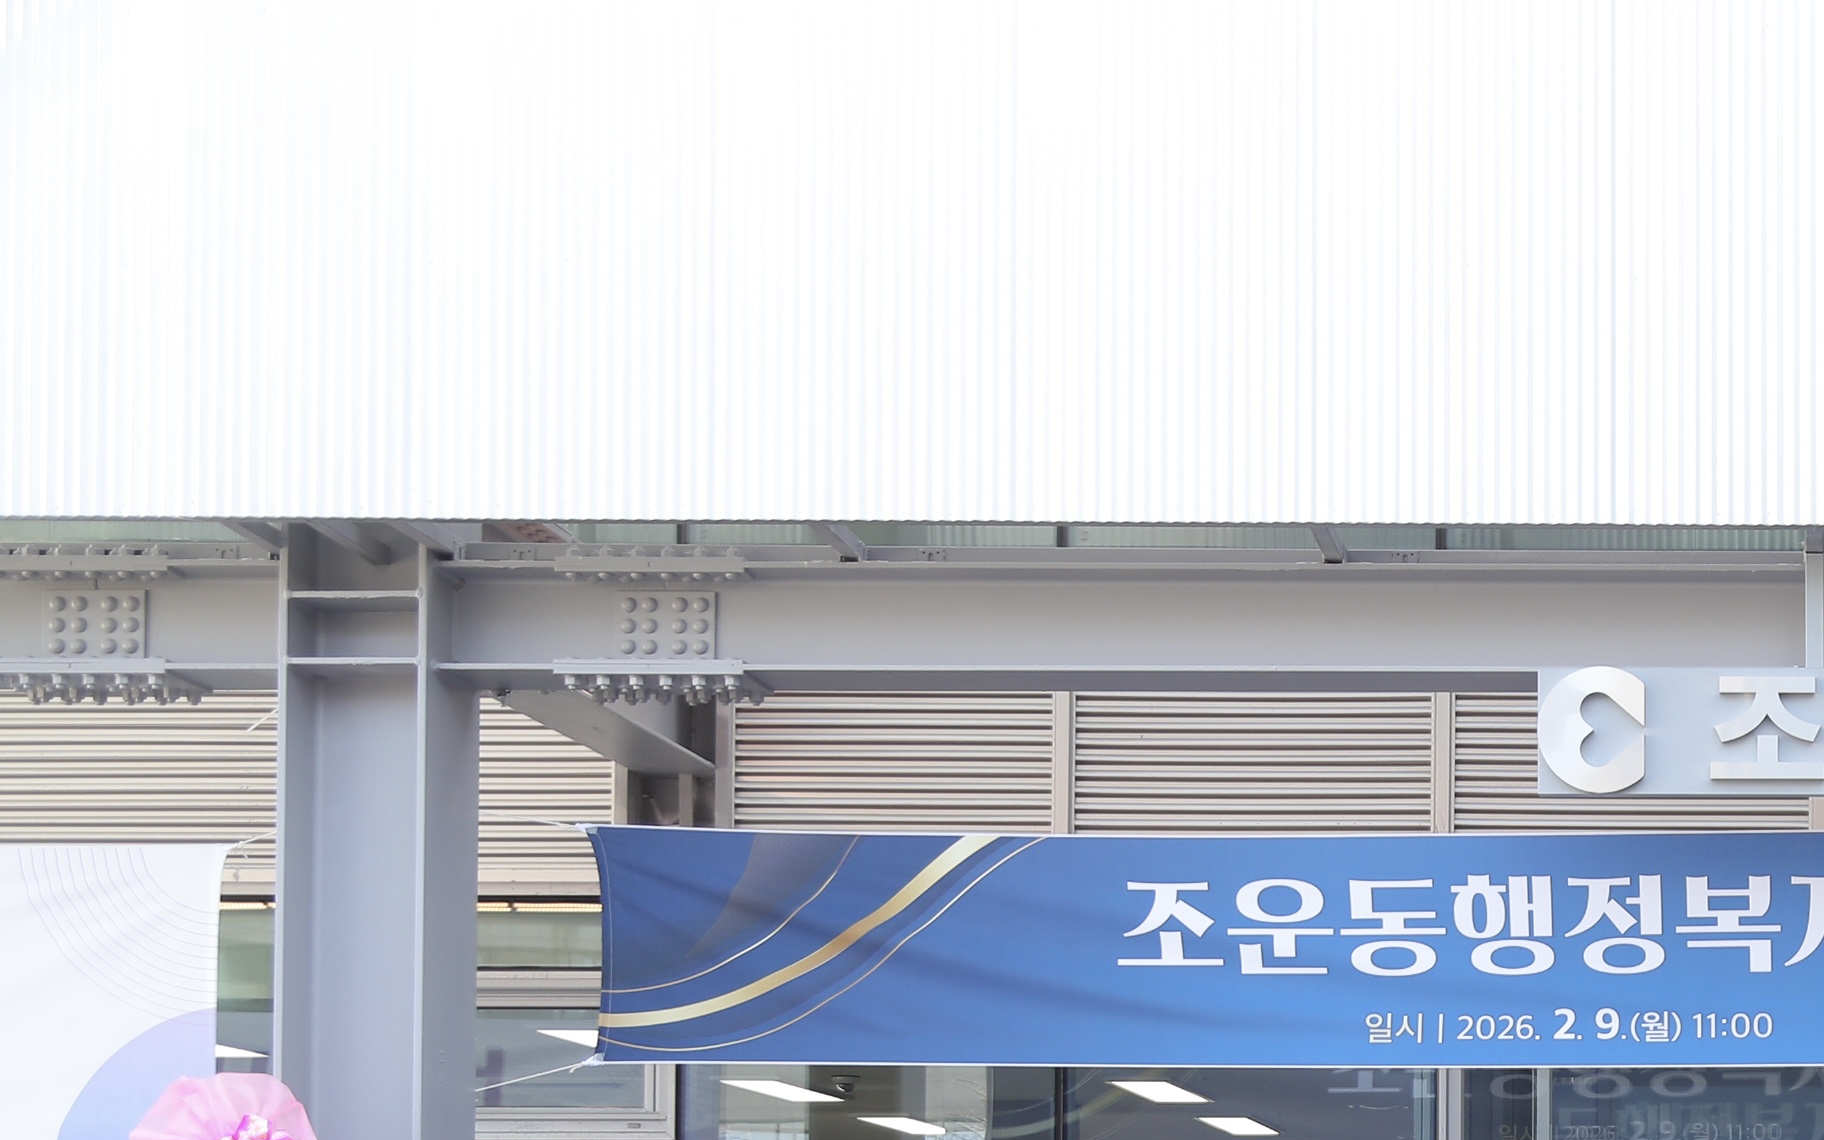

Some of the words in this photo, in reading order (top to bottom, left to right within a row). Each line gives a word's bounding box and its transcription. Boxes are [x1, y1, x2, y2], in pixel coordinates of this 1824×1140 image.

[1364, 1012, 1424, 1045] 일시
[1456, 1014, 1542, 1041] 2026.
[1692, 1012, 1774, 1040] 11:00
